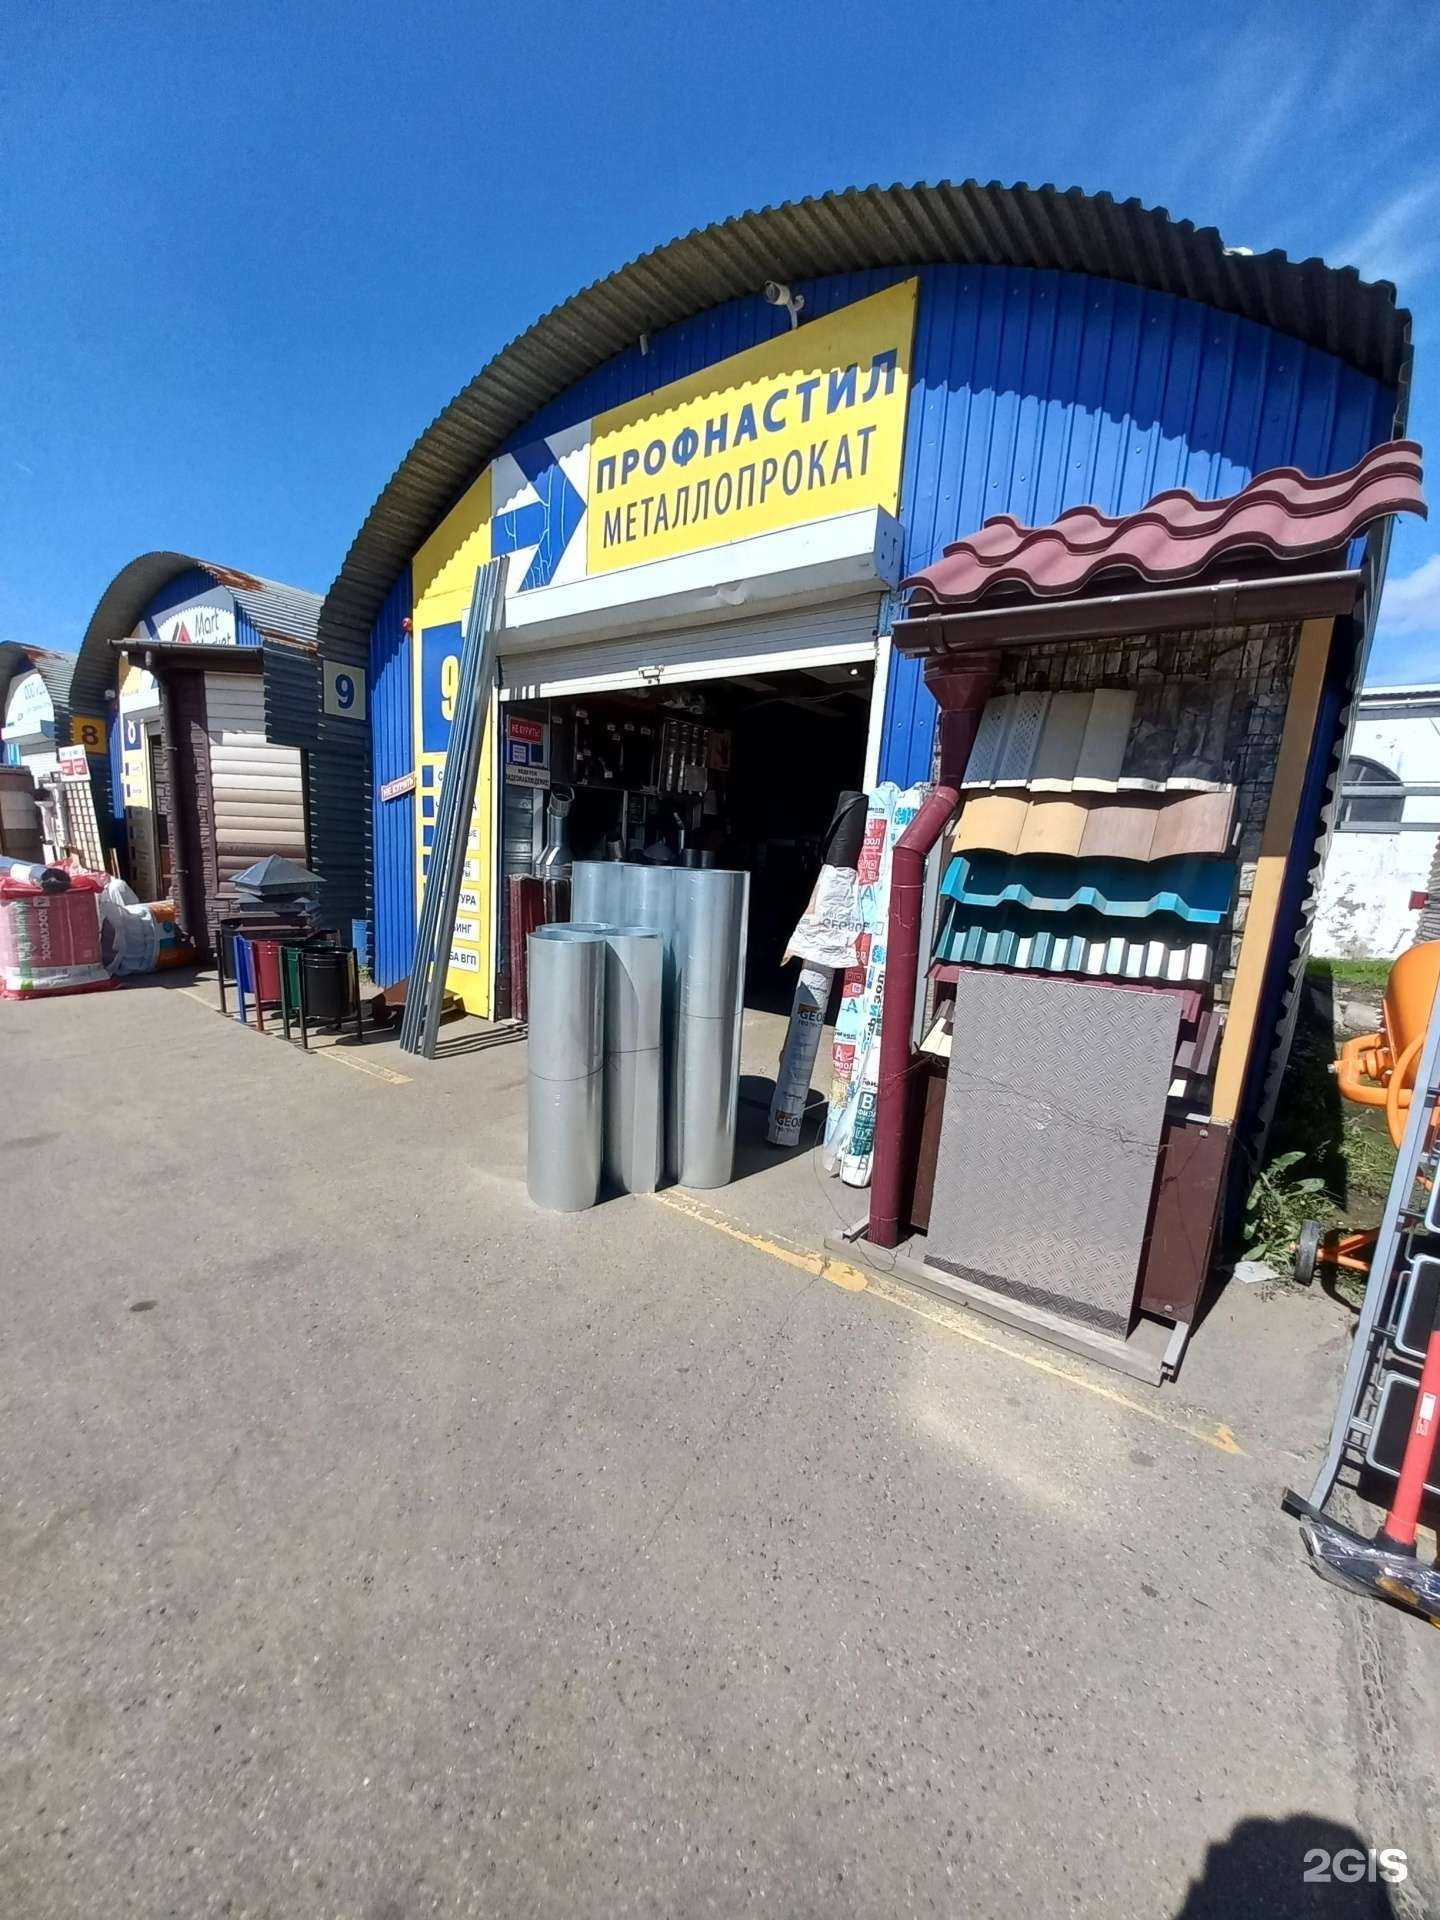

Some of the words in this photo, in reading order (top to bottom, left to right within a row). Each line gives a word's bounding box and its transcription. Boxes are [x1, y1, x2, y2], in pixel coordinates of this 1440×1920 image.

[596, 347, 898, 494] ПРОФНАСТИЛ
[603, 425, 877, 548] МЕТАЛЛОПРОКАТ
[195, 611, 220, 637] Mart
[335, 673, 355, 710] 9
[441, 655, 460, 721] 9
[81, 725, 98, 745] 8
